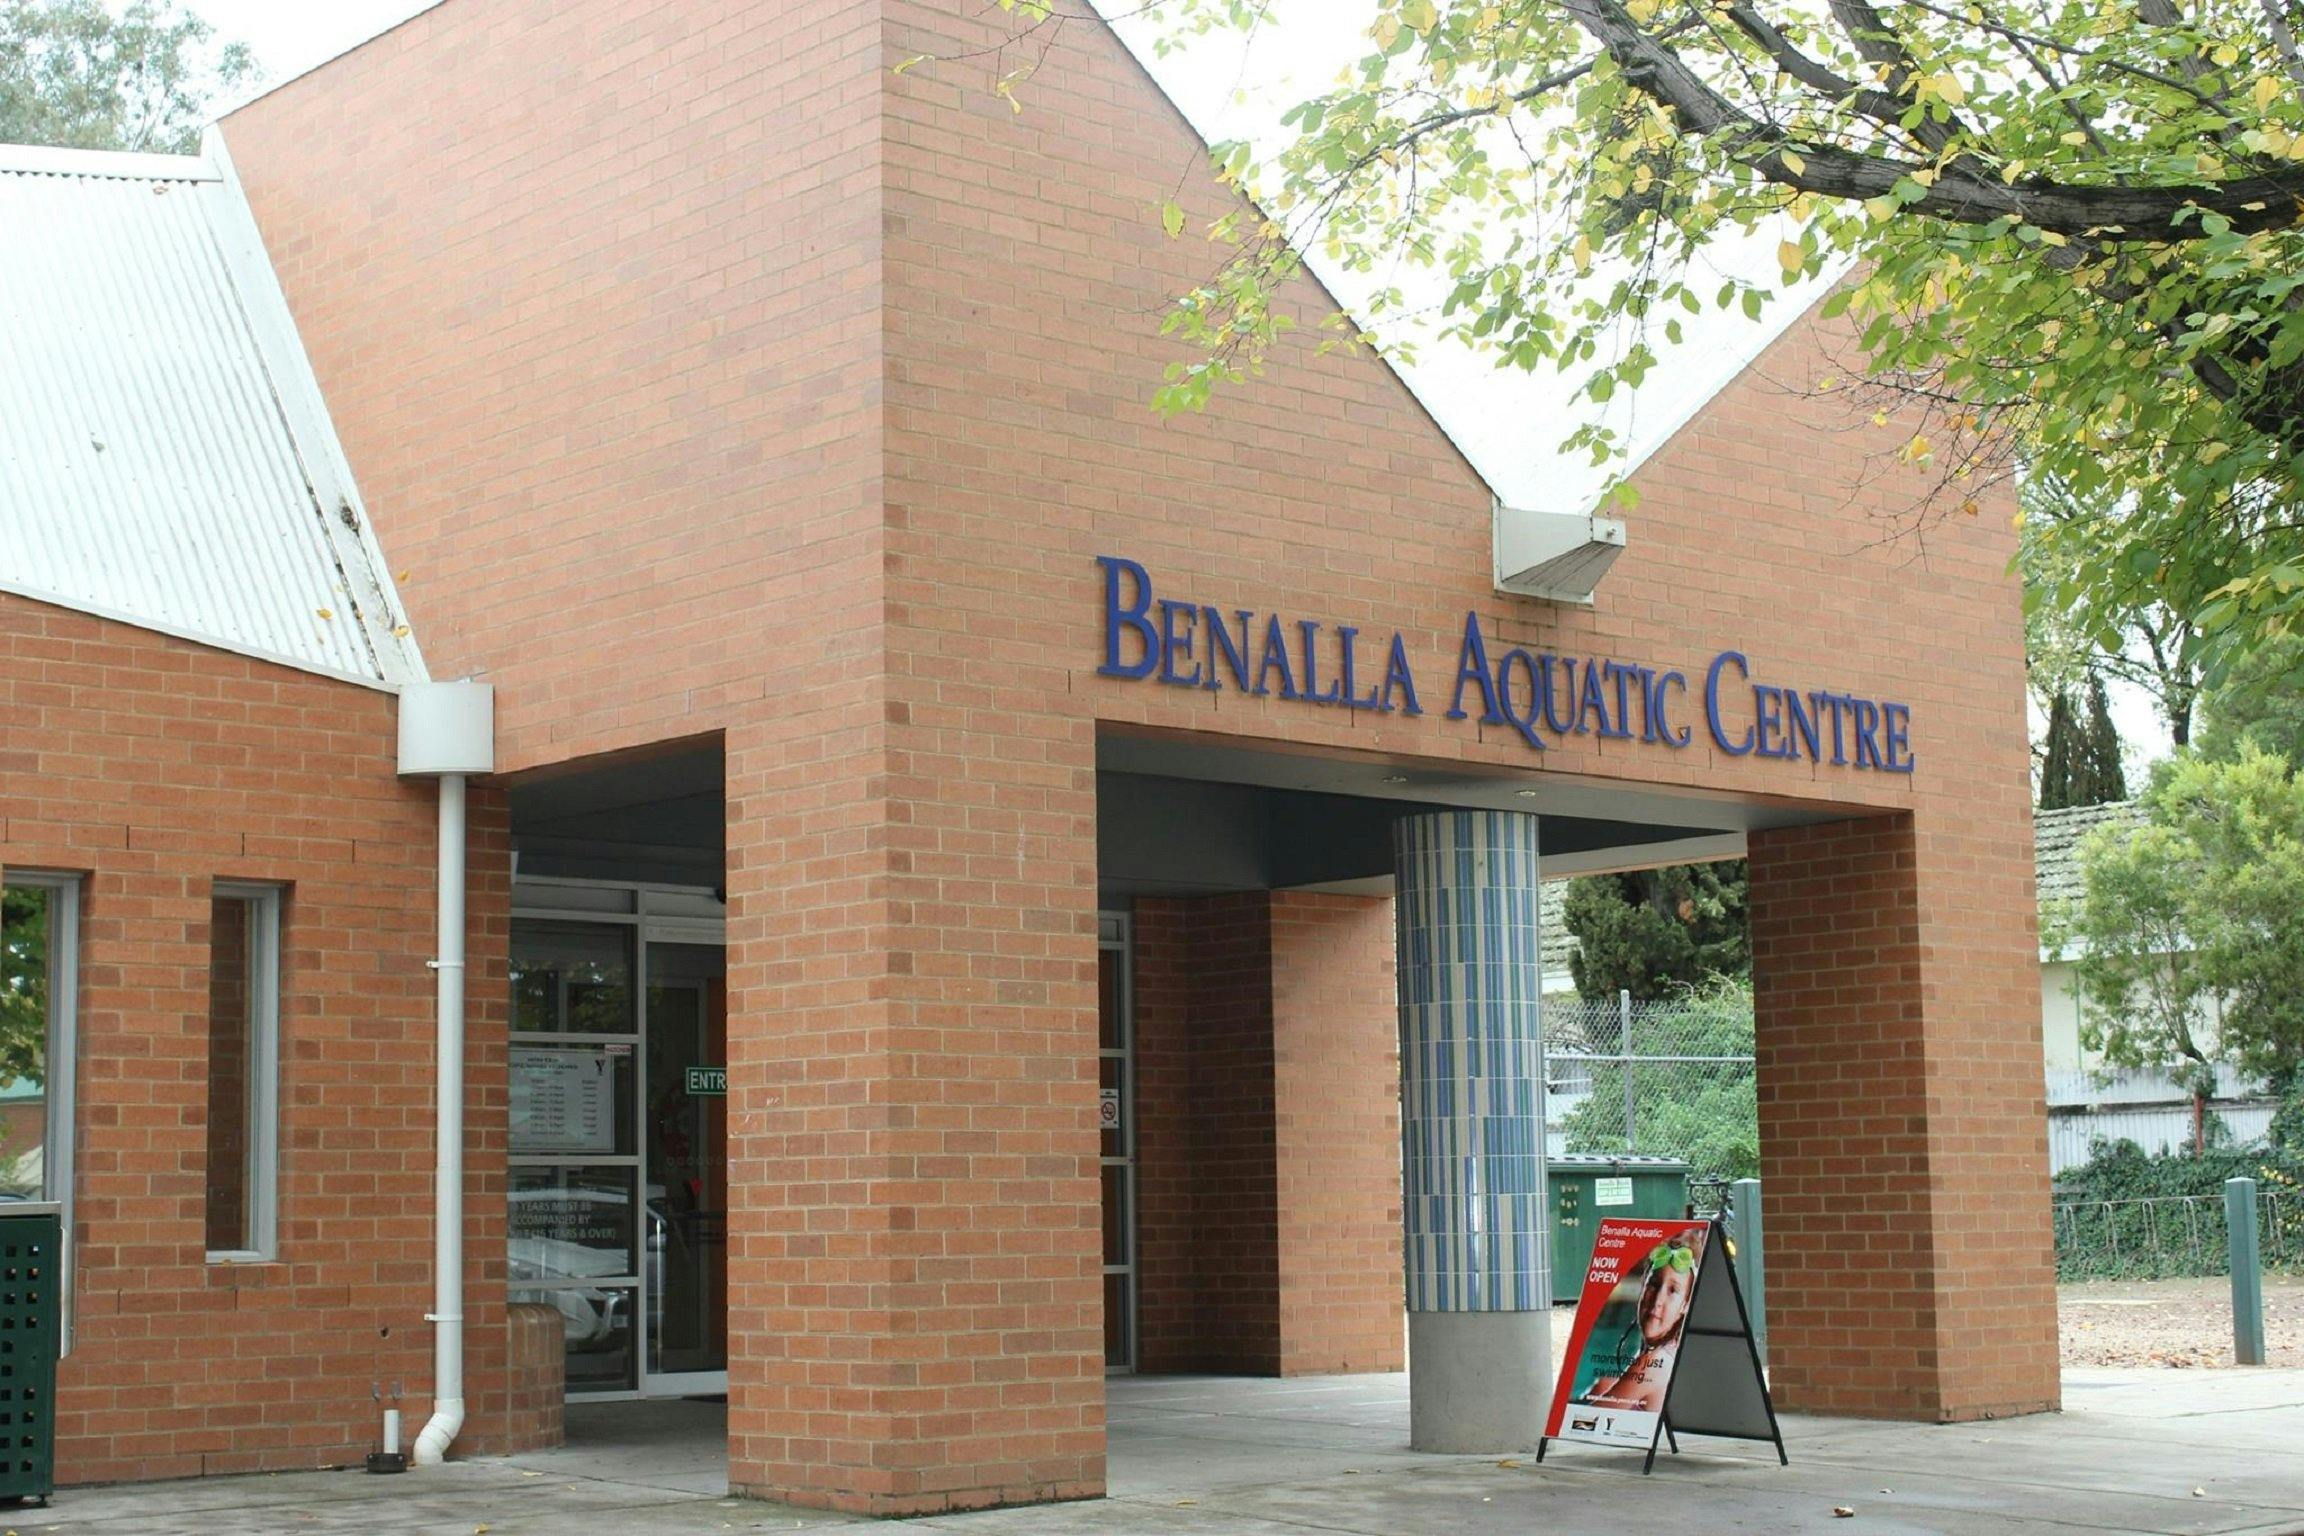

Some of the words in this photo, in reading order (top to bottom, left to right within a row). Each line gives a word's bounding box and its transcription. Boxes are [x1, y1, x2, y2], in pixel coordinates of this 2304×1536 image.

[1097, 555, 1424, 716] BENALLA
[1446, 610, 1691, 750] AQUATIC
[1706, 651, 1914, 773] CENTRE
[1601, 1224, 1631, 1237] Benalla
[1631, 1227, 1664, 1239] Aquatic
[1598, 1237, 1626, 1248] Centre
[1592, 1257, 1619, 1268] NOW
[1589, 1270, 1619, 1284] OPEN
[1642, 1357, 1664, 1370] just
